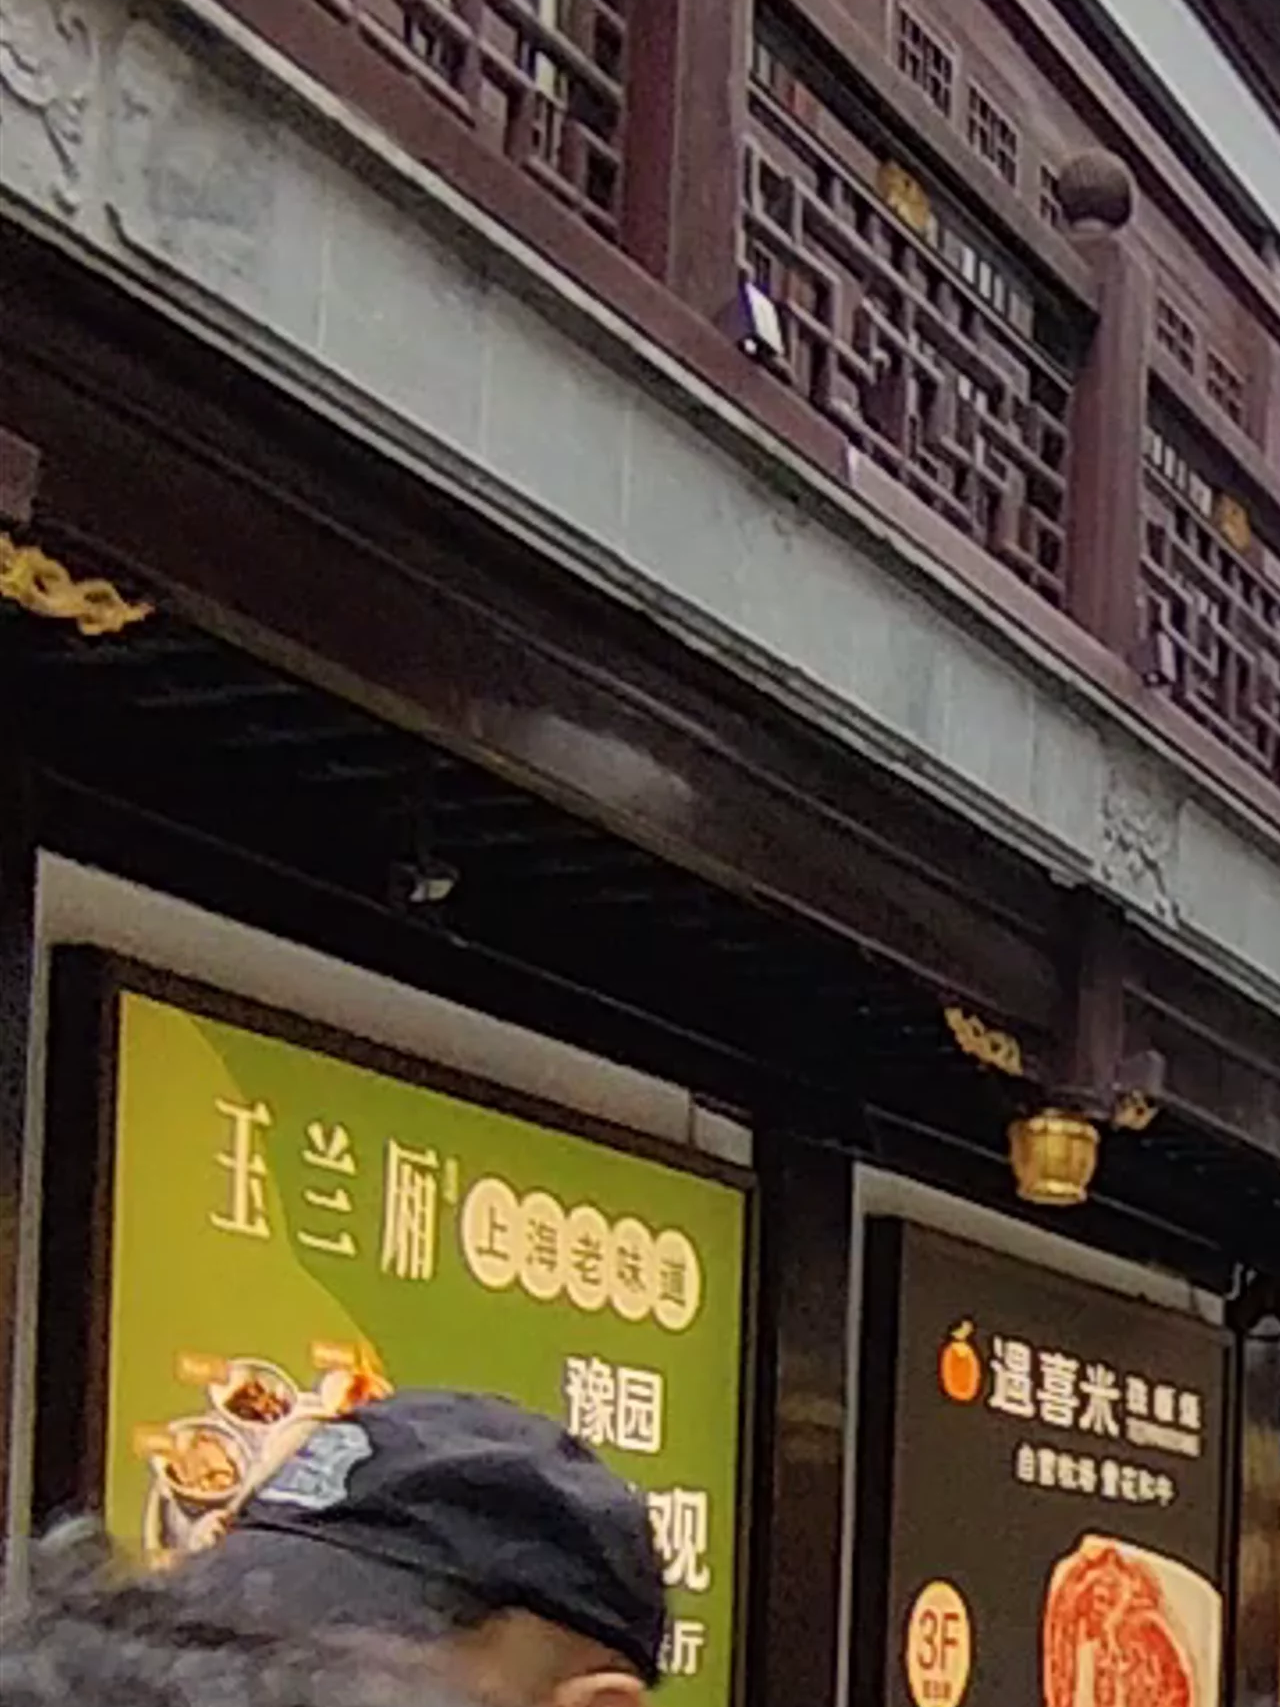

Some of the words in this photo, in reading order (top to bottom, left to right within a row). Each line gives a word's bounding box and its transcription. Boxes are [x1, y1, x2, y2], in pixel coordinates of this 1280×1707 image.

[565, 1356, 663, 1454] 豫园
[645, 1487, 711, 1592] 观
[656, 1619, 705, 1676] 厅
[917, 1609, 960, 1671] 3F
